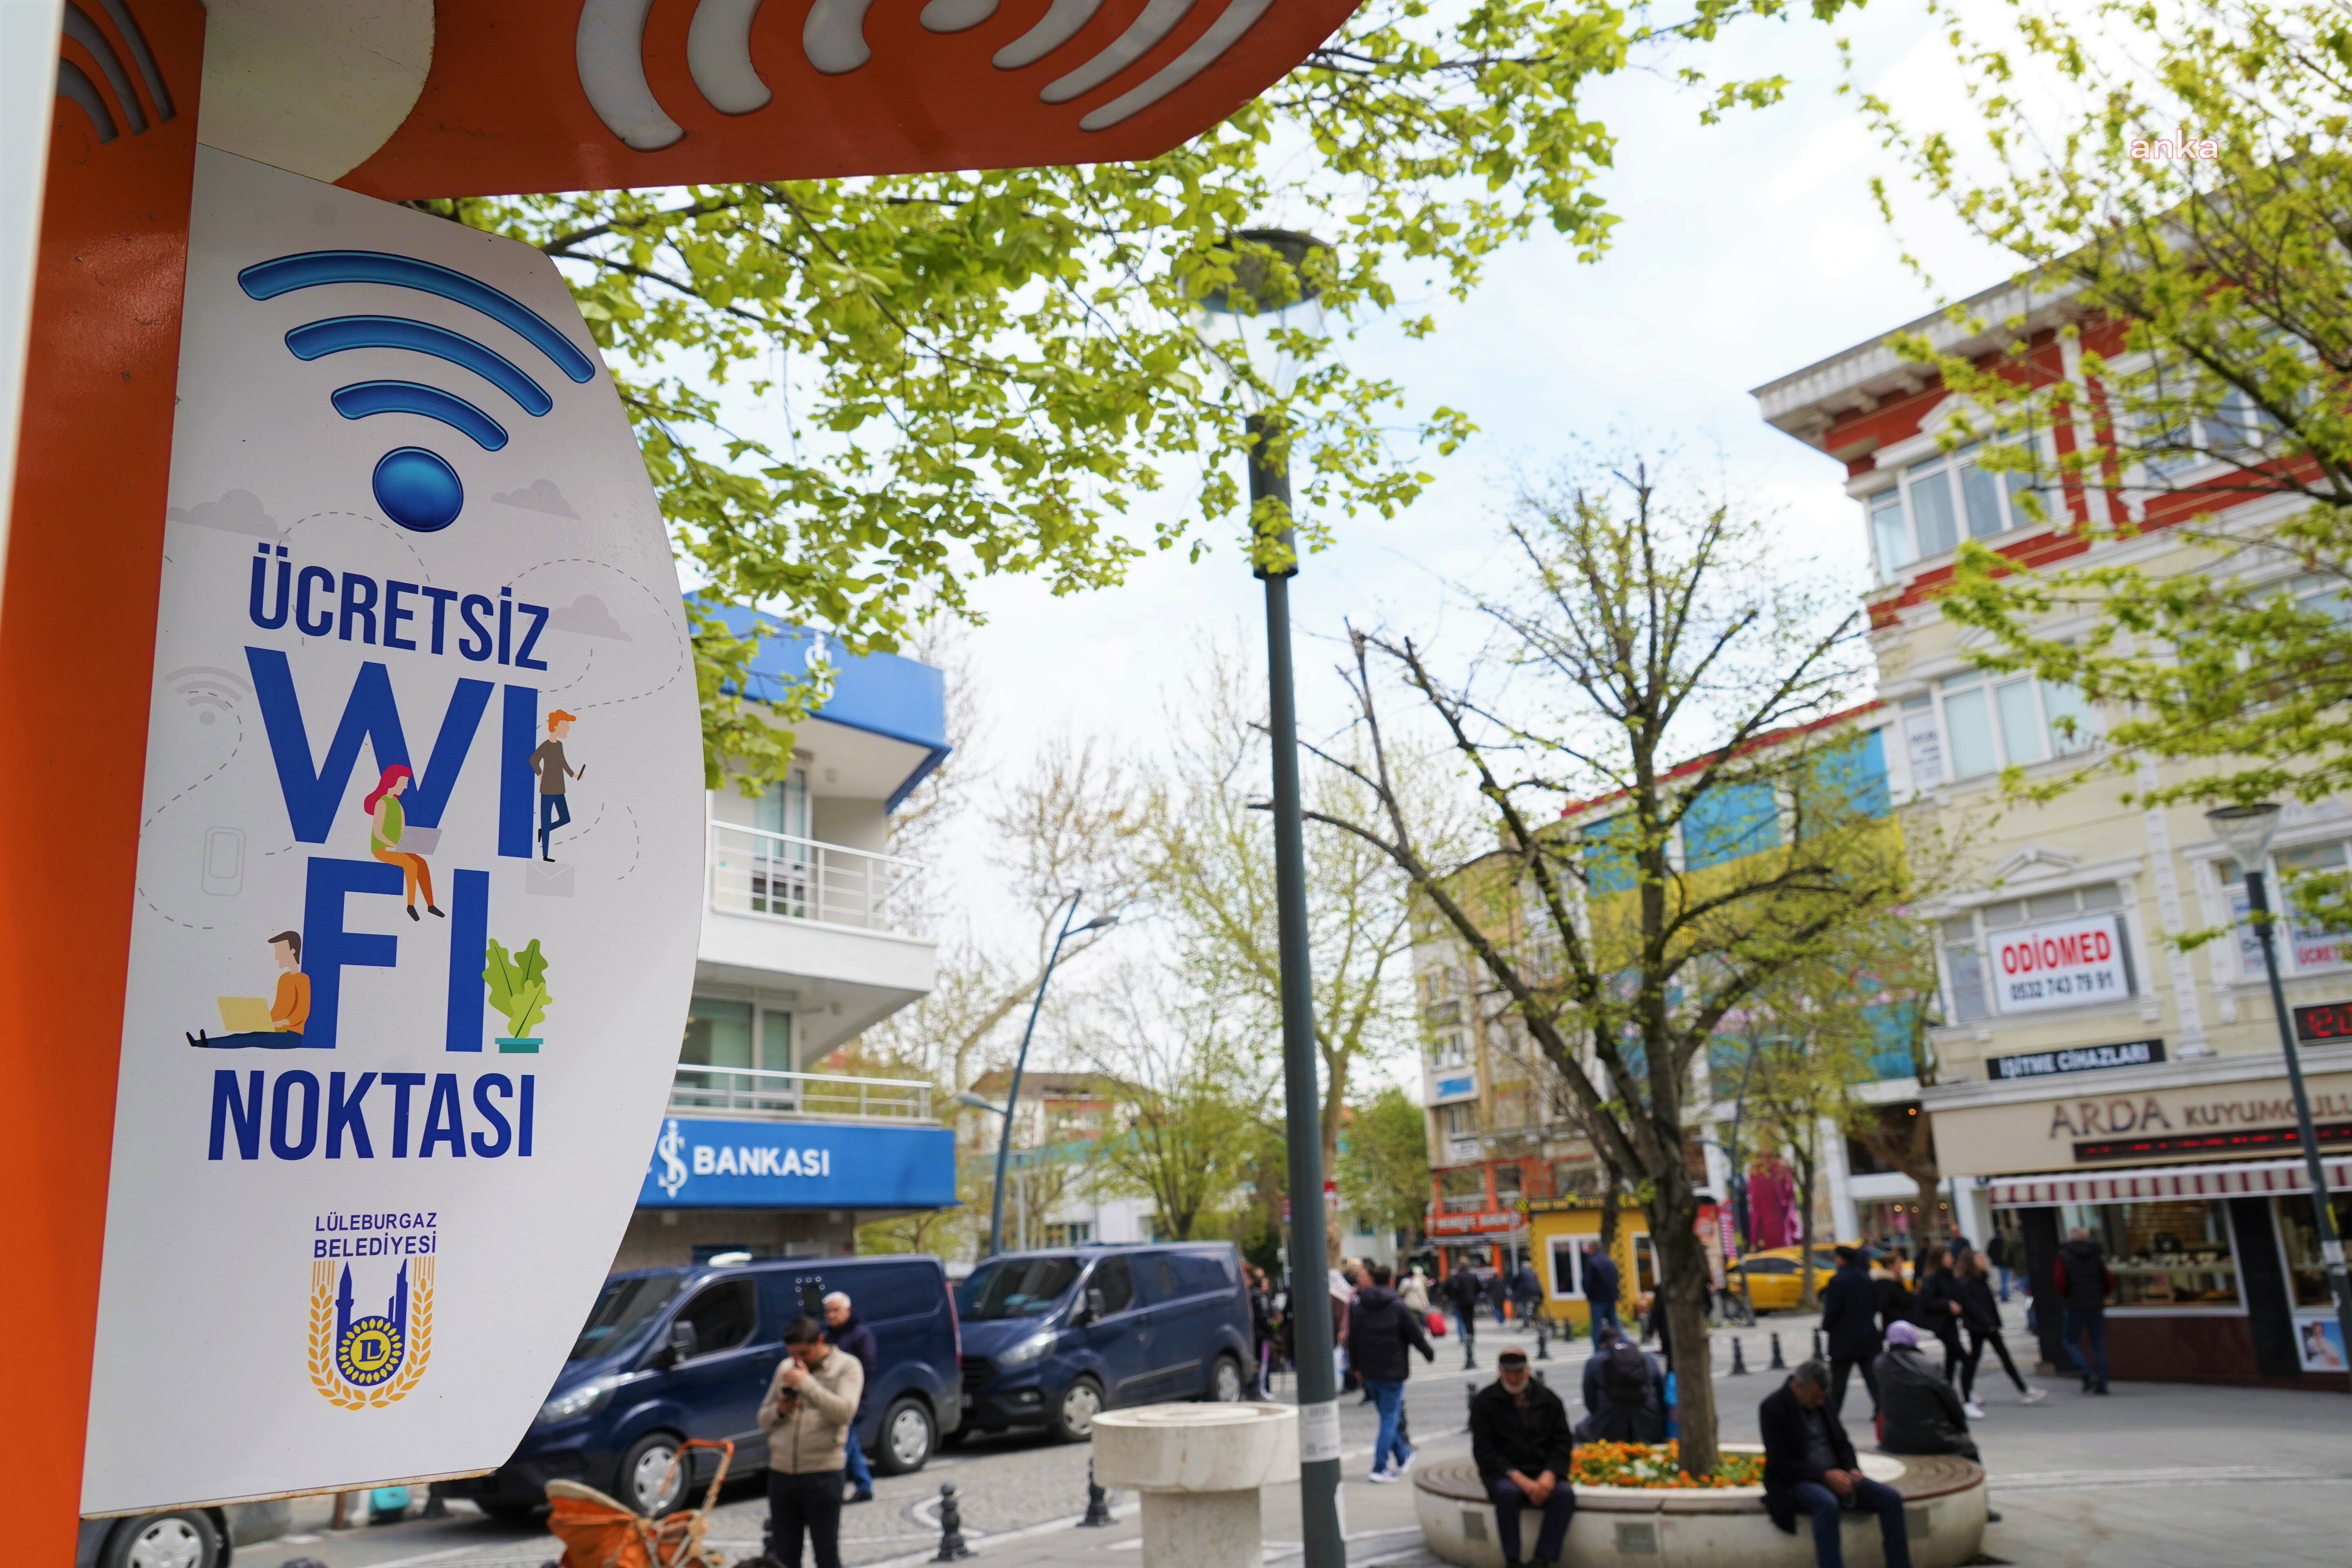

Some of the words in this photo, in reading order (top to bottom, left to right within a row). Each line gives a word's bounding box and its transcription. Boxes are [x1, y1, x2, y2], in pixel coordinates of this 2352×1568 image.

[249, 542, 549, 671] ÜCRETSİZ
[2056, 1043, 2151, 1072] CİHAZLARI
[208, 1069, 535, 1161] NOKTASI
[2049, 1098, 2173, 1140] ARDA
[693, 1145, 830, 1176] BANKASI
[315, 1212, 437, 1232] LÜLEBURGAZ
[314, 1230, 436, 1258] BELEDİYESİ
